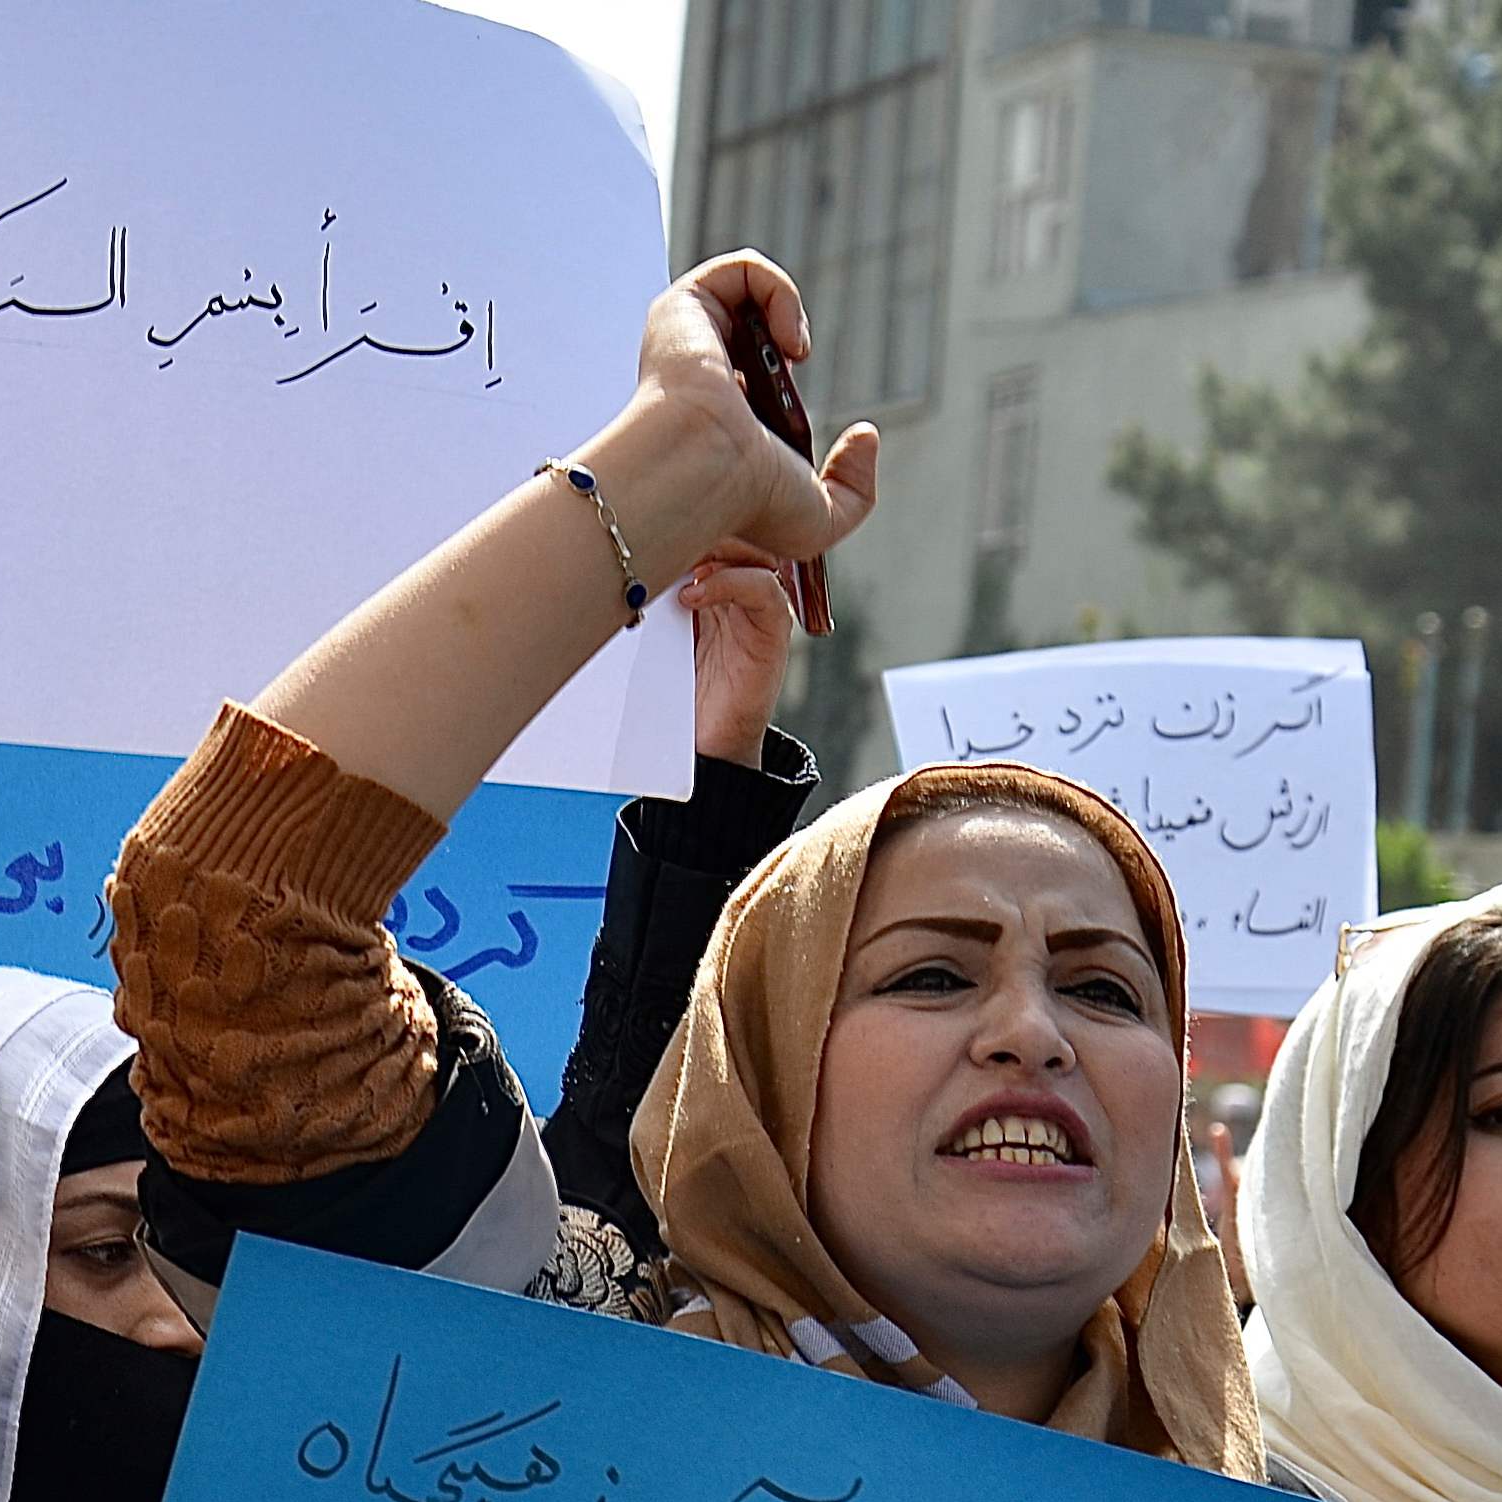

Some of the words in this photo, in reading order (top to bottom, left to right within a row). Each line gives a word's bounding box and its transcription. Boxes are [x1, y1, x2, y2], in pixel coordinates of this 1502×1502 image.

[943, 708, 1033, 761] خدا
[1153, 694, 1234, 739] زن
[1221, 780, 1329, 851] ارزش
